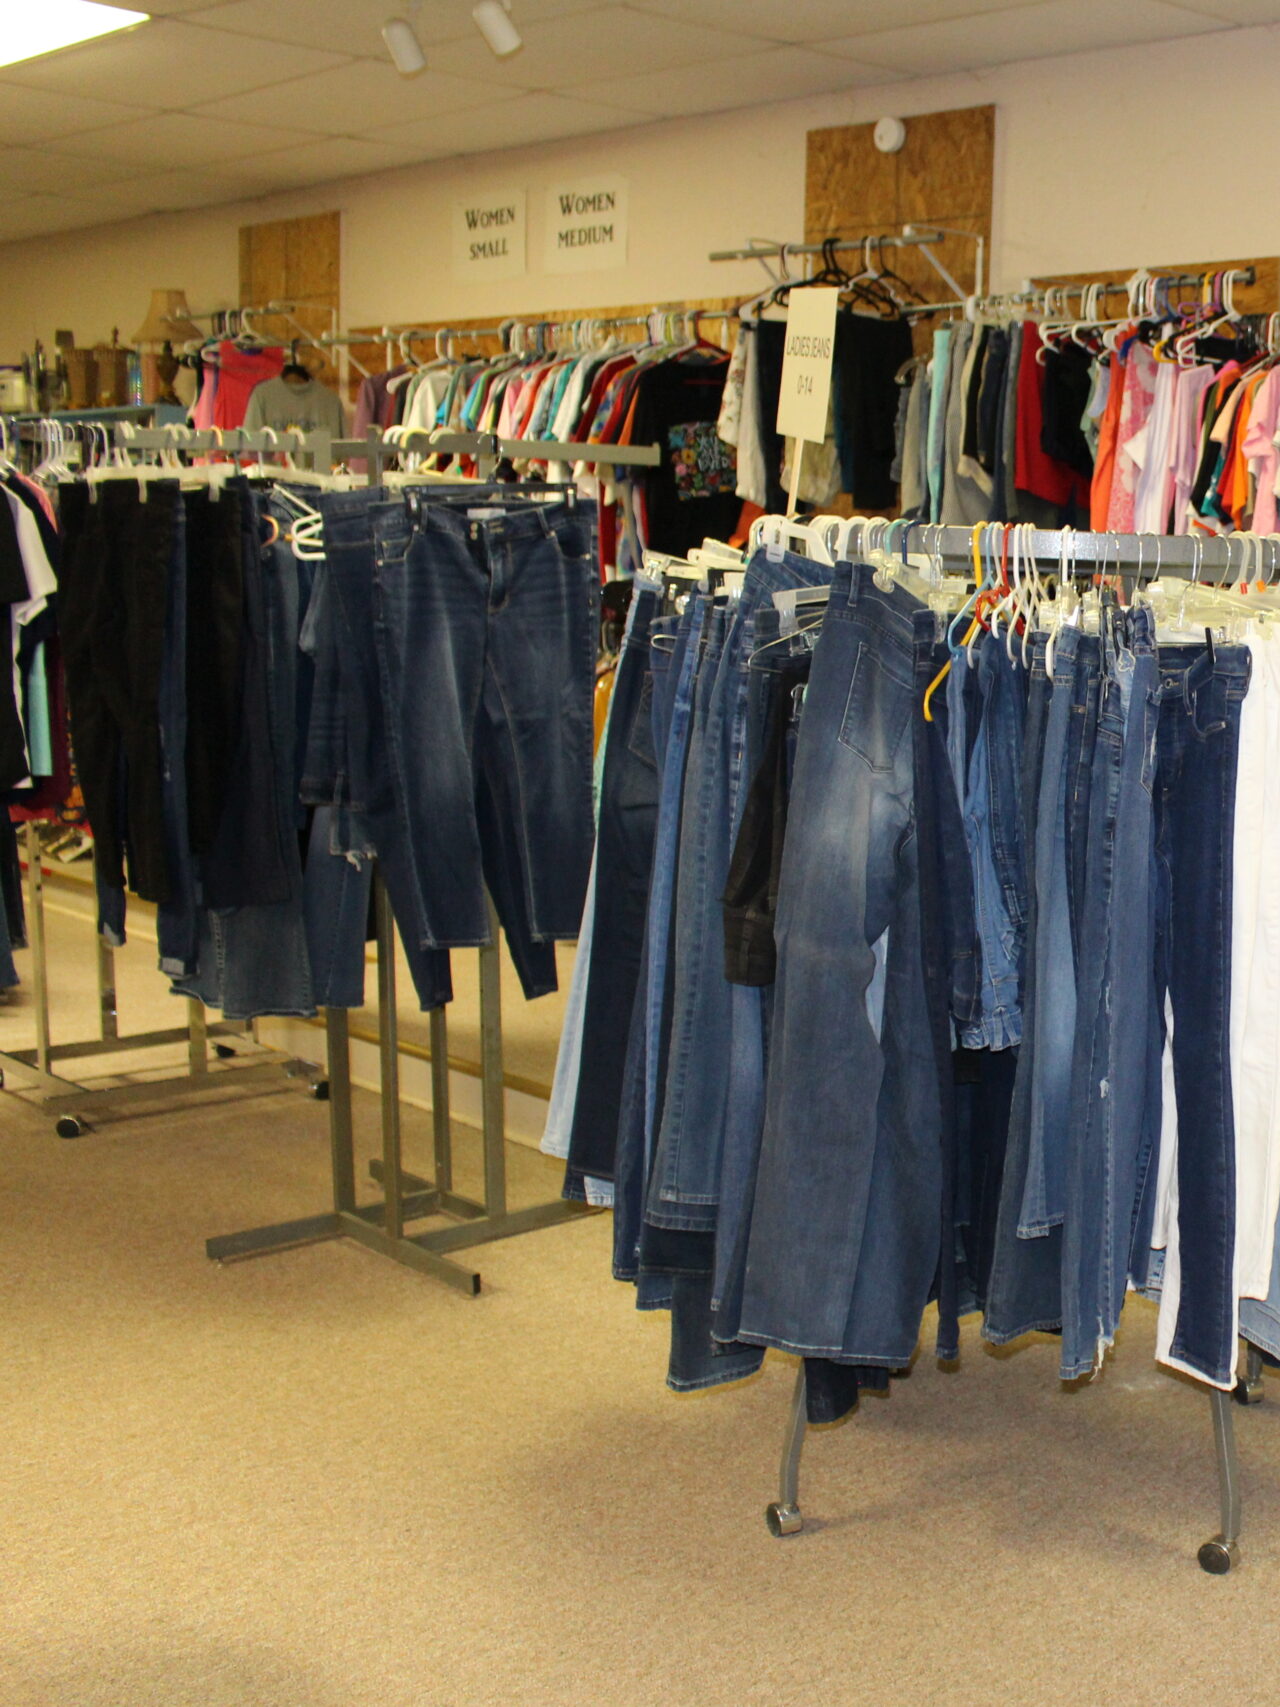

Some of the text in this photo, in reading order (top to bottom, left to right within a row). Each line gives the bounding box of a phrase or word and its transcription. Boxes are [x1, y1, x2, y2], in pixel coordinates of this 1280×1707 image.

[558, 191, 616, 217] WOMEN
[465, 205, 516, 231] WOMEN
[469, 238, 509, 260] SMALL
[558, 224, 614, 249] MEDIUM
[786, 336, 831, 359] LADIES JEANS
